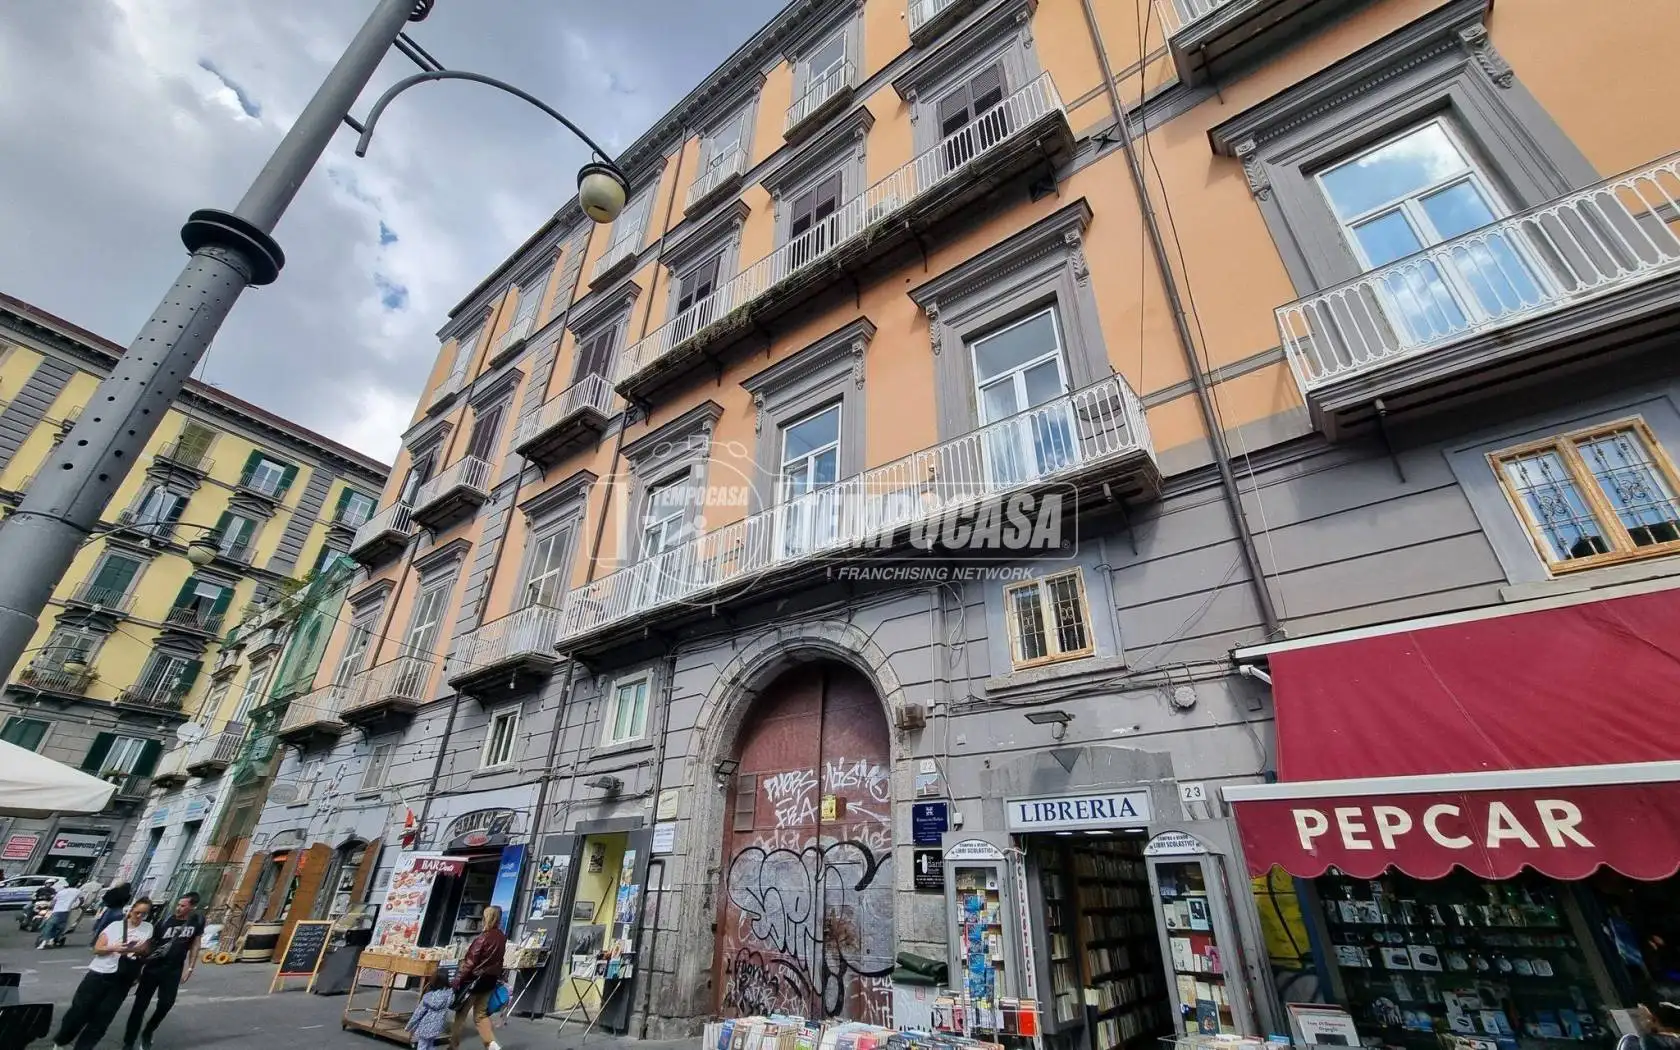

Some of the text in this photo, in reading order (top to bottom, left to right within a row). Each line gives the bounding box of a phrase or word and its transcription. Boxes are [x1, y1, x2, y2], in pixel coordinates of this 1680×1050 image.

[1185, 787, 1200, 798] 23
[1021, 797, 1138, 823] LIBRERIA
[1292, 799, 1596, 850] PEPCAR
[421, 860, 438, 870] BAR
